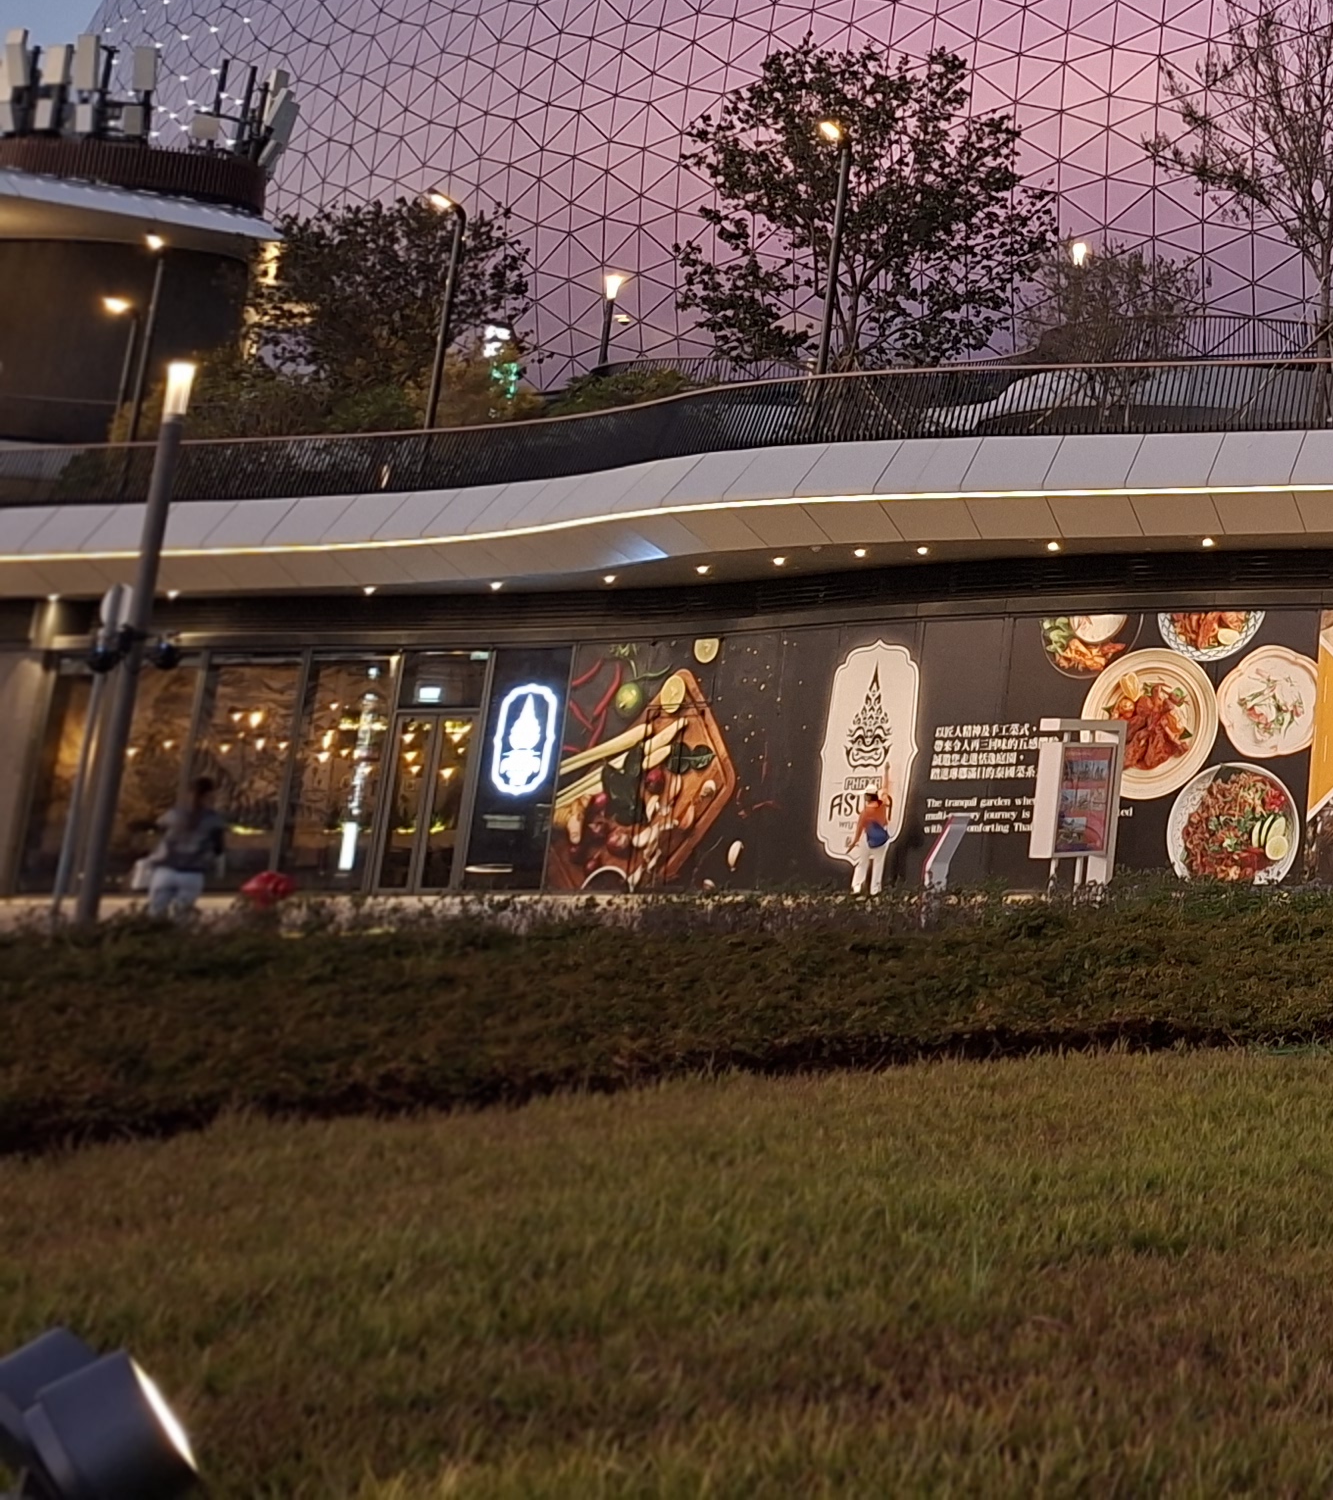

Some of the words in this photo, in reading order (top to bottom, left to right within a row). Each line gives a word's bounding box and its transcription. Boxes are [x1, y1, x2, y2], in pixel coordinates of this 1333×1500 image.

[829, 793, 893, 822] ASUA
[927, 799, 944, 808] The
[945, 797, 977, 809] tranquil
[980, 797, 1011, 809] garden
[984, 810, 1017, 822] journey
[1022, 809, 1031, 819] is
[924, 823, 942, 834] with
[966, 822, 1009, 834] omforting
